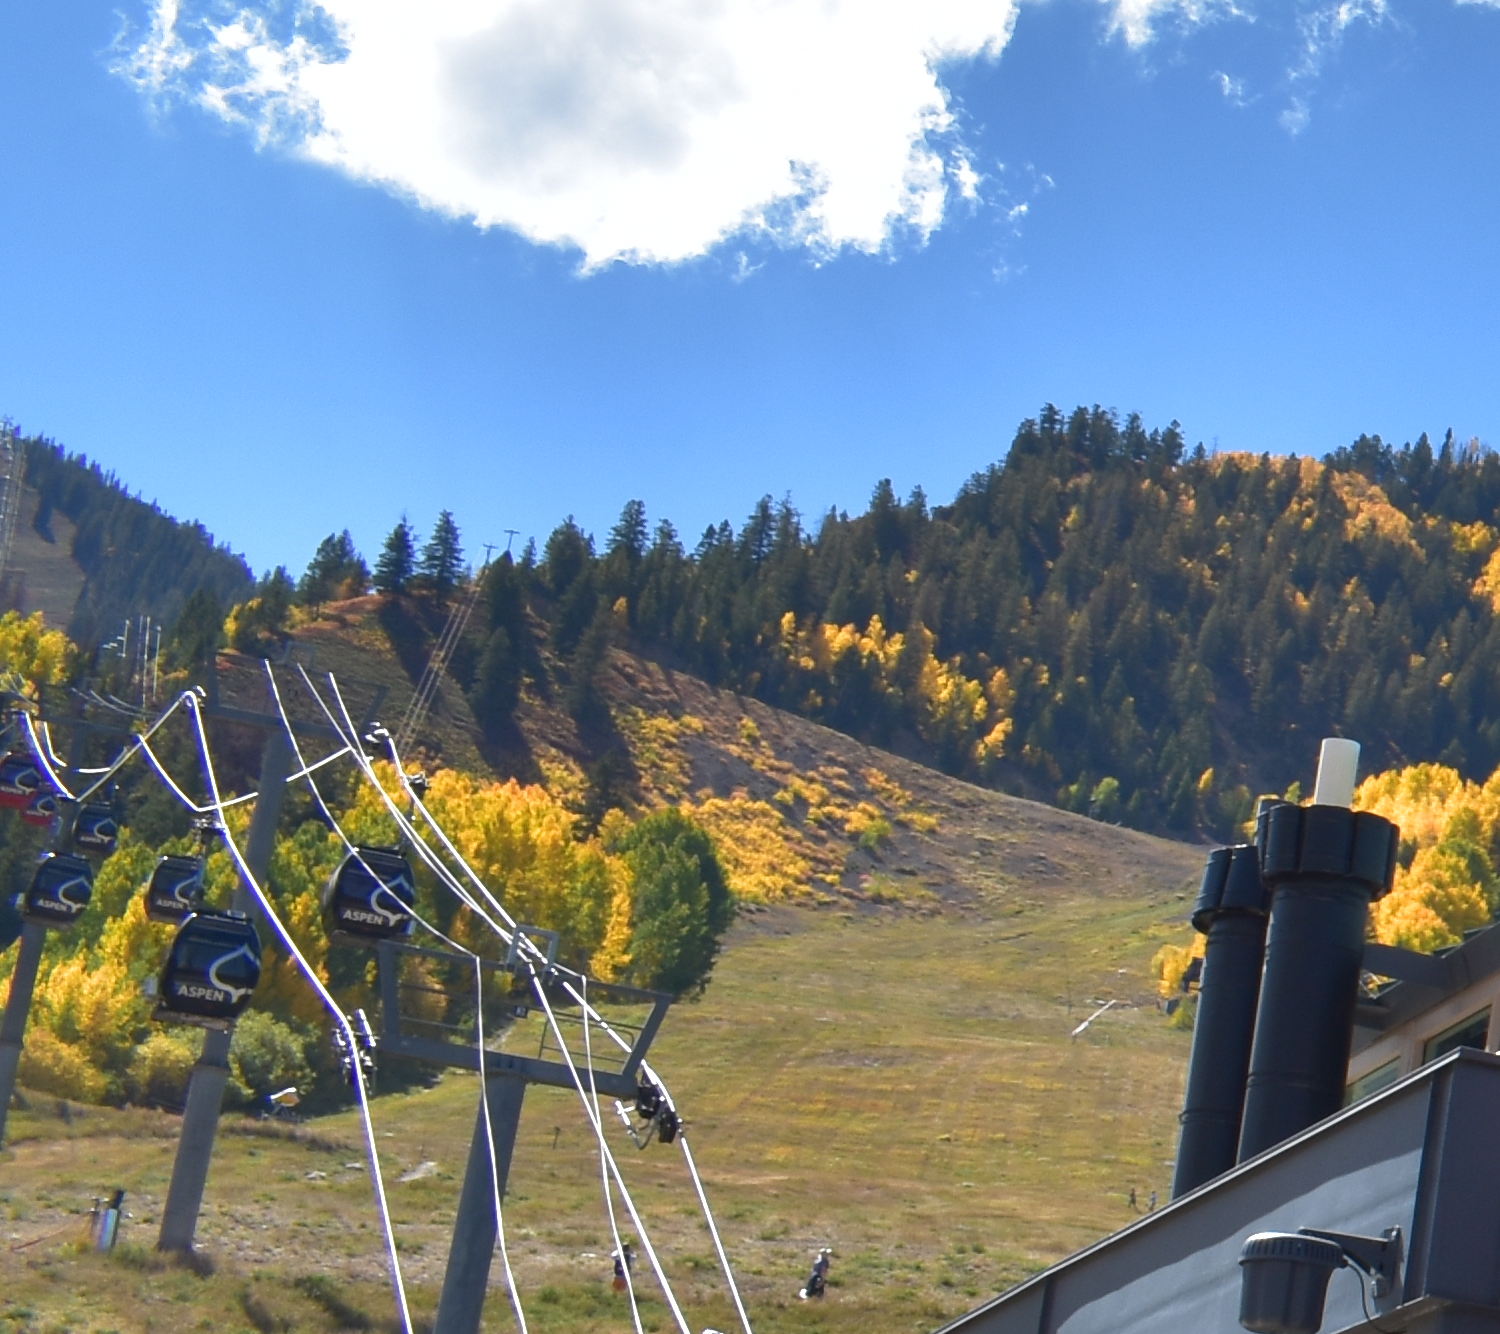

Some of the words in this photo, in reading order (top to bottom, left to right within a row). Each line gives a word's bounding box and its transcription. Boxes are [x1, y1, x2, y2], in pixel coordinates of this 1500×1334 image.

[37, 898, 67, 913] ASPEN
[156, 898, 184, 910] ASPEN
[342, 909, 384, 926] ASPEN
[178, 984, 225, 1003] ASPEN
